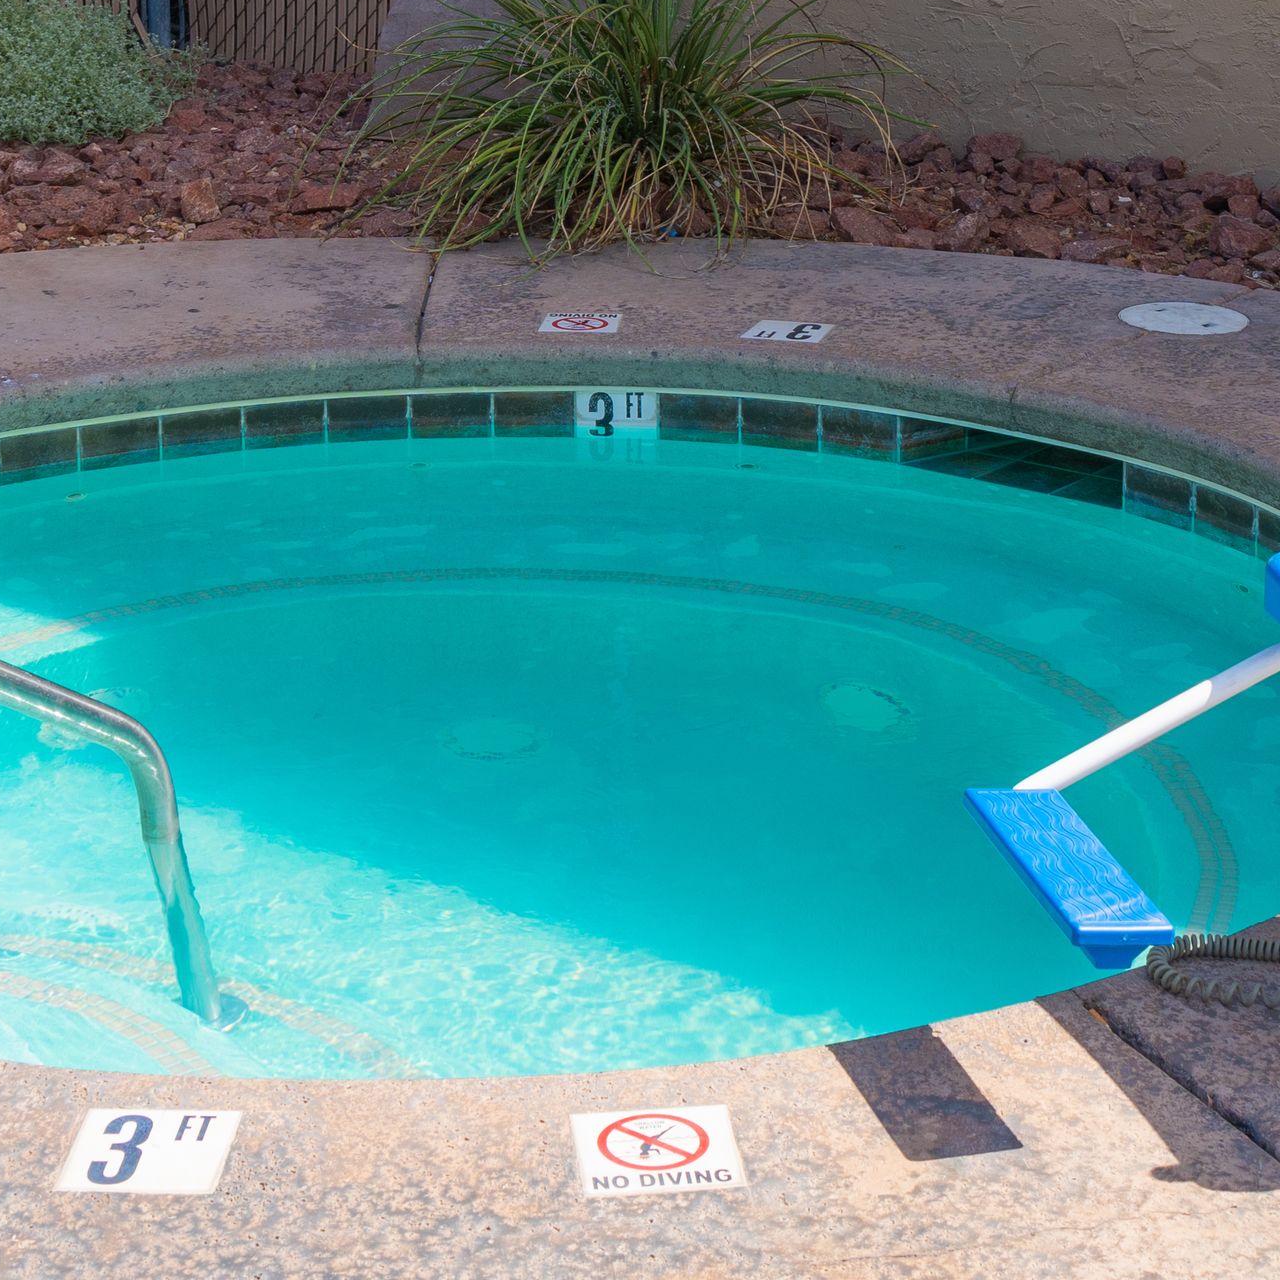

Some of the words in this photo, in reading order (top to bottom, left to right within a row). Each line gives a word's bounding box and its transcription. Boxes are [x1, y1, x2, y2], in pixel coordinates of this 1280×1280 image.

[756, 330, 775, 339] FT
[786, 323, 821, 340] 3
[588, 392, 614, 437] 3
[625, 392, 644, 419] FT
[86, 1114, 154, 1185] 3
[174, 1115, 217, 1142] FT
[592, 1175, 630, 1190] NO
[639, 1169, 733, 1187] DIVING
